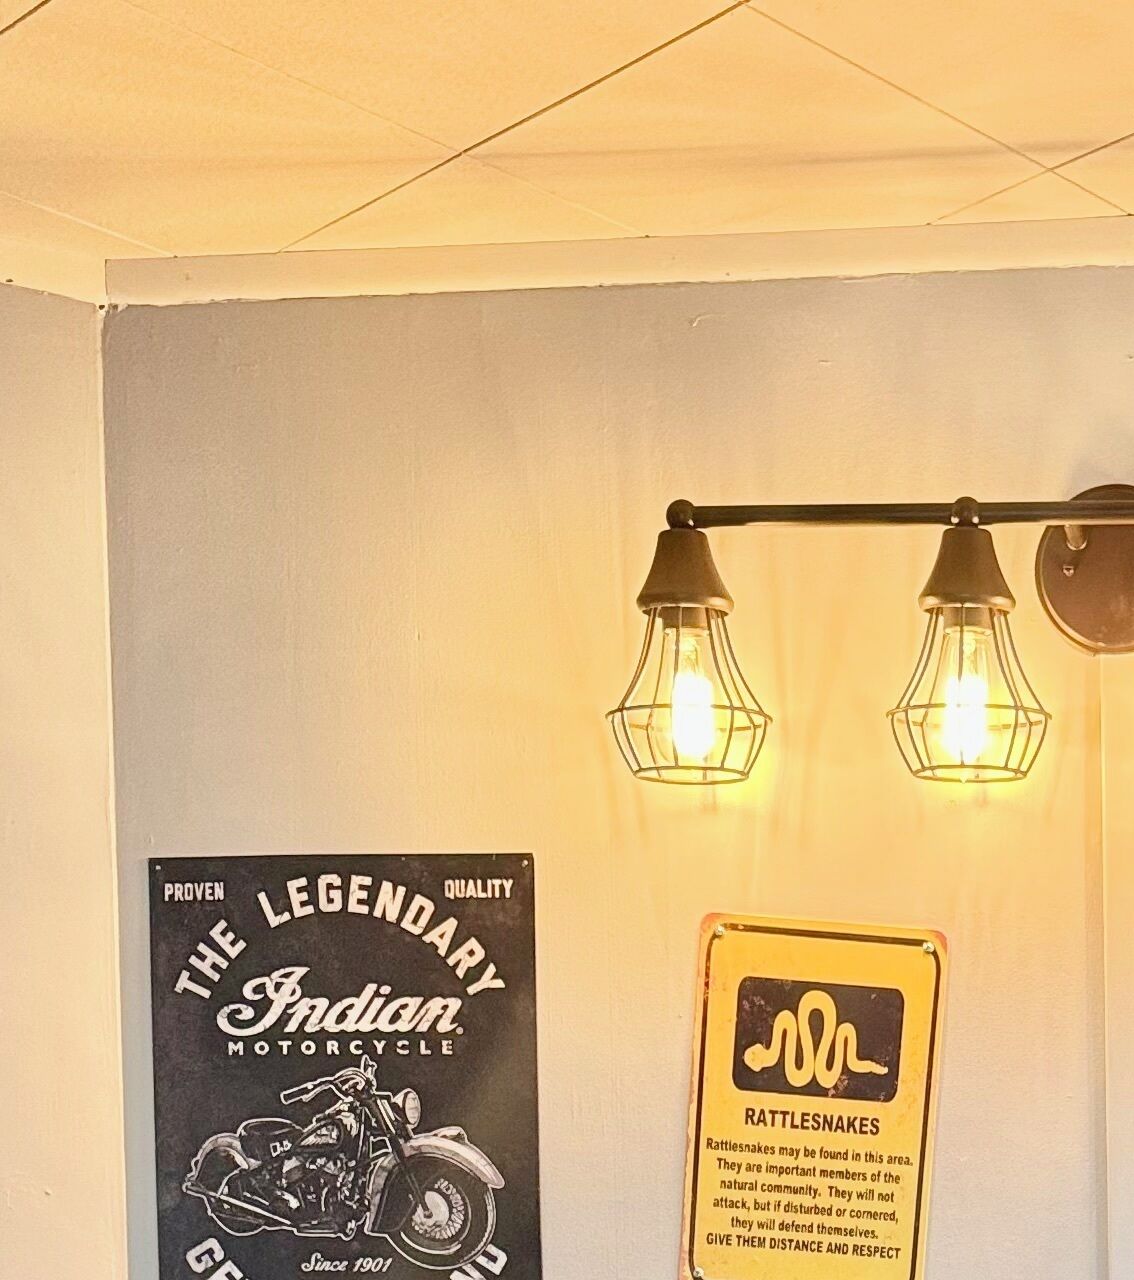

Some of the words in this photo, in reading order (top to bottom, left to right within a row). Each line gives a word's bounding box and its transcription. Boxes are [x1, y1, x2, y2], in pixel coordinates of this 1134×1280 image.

[163, 880, 225, 902] PROVEN
[444, 879, 514, 899] QUALITY
[174, 919, 247, 1000] THE
[256, 874, 506, 996] LEGENDARY
[227, 1039, 455, 1056] MOTORCYCLE
[745, 1107, 880, 1136] RATTLESNAKES
[706, 1137, 776, 1155] Rattlesnakes
[779, 1145, 800, 1160] may
[804, 1146, 816, 1159] be
[819, 1147, 849, 1161] found
[852, 1149, 861, 1162] in
[864, 1150, 884, 1164] this
[887, 1154, 914, 1166] area.
[717, 1158, 742, 1174] They
[745, 1162, 762, 1173] are
[765, 1161, 817, 1178] important
[819, 1167, 868, 1182] members
[870, 1170, 881, 1183] of
[884, 1171, 901, 1184] the
[719, 1178, 758, 1192] natural
[760, 1181, 822, 1198] community.
[827, 1185, 853, 1202] They
[856, 1188, 874, 1201] will
[877, 1190, 895, 1203] not
[713, 1196, 751, 1212] attack,
[754, 1198, 771, 1212] but
[774, 1200, 781, 1212] if
[783, 1200, 833, 1217] disturbed
[836, 1207, 847, 1217] or
[849, 1207, 899, 1224] cornered,
[731, 1216, 754, 1232] they
[757, 1218, 776, 1231] will
[778, 1220, 814, 1234] defend
[817, 1222, 879, 1239] themselves.
[706, 1232, 733, 1246] GIVE
[736, 1234, 766, 1248] THEM
[769, 1237, 824, 1253] DISTANCE
[826, 1241, 849, 1255] AND
[852, 1243, 901, 1259] RESPECT
[301, 1252, 349, 1274] Since
[353, 1256, 394, 1274] 1901
